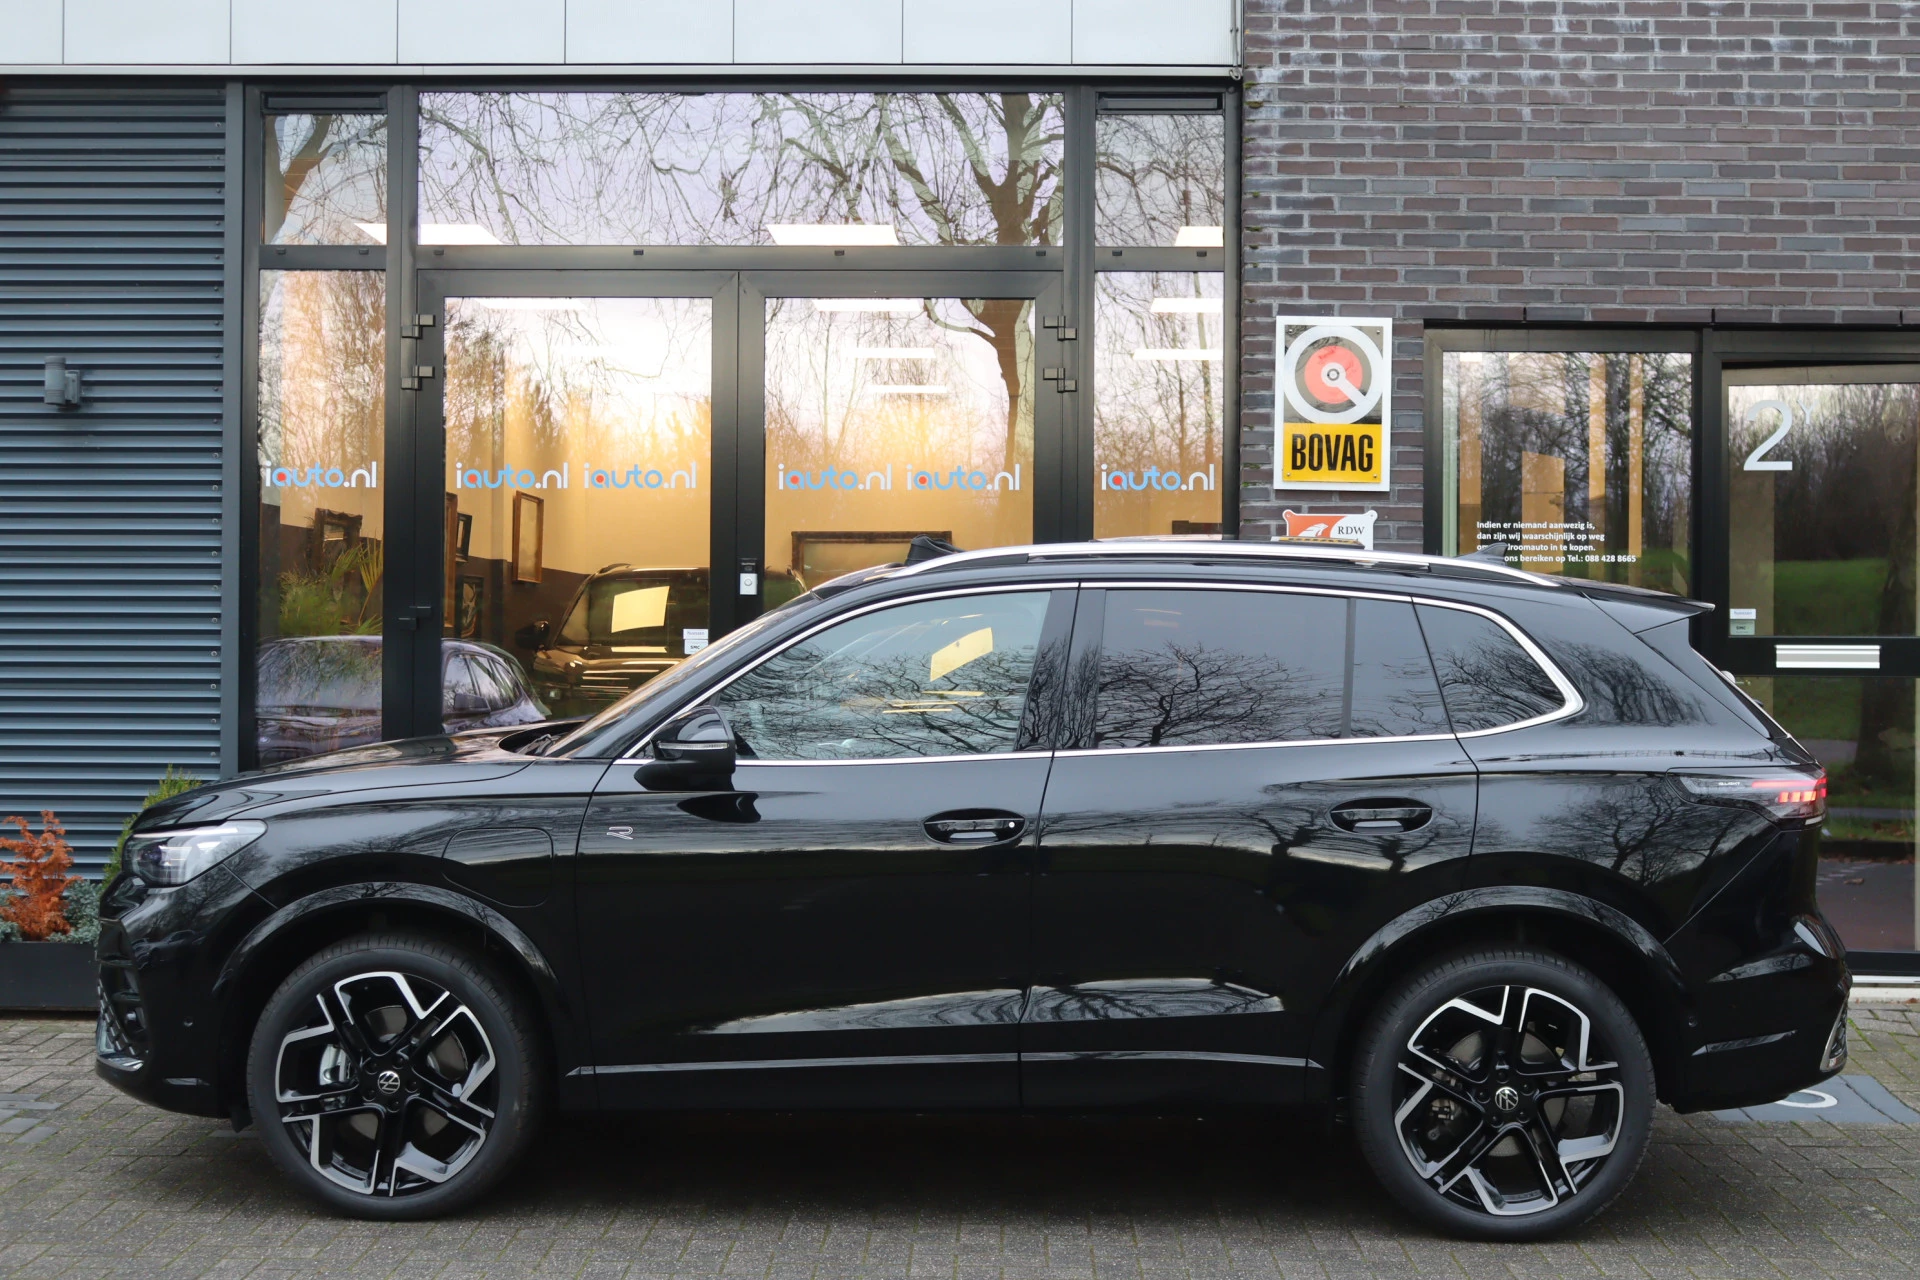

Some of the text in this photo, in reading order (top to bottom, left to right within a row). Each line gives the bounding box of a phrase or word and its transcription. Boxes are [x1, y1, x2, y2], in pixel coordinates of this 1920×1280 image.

[1291, 433, 1374, 472] BOVAG
[264, 460, 378, 489] iauto.nl
[456, 461, 697, 490] iauto.nl iauto.nl
[777, 463, 1021, 491] iauto.nl iauto.nl
[1100, 463, 1215, 491] iauto.nl
[1337, 526, 1365, 535] RDW
[1476, 521, 1501, 529] Indien
[1513, 521, 1547, 529] niemand
[1549, 521, 1585, 530] aanwezig
[1586, 521, 1595, 530] is,
[1476, 532, 1605, 541] dan zijn wij waarschijnlijk op weg
[1550, 543, 1558, 551] in
[1560, 543, 1568, 551] te
[1569, 543, 1596, 552] kopen.
[1520, 554, 1553, 562] bereiken
[1555, 555, 1566, 563] op
[1567, 554, 1583, 562] Tel.:
[1585, 554, 1600, 562] 088
[1601, 554, 1616, 562] 428
[1617, 554, 1637, 562] 8665
